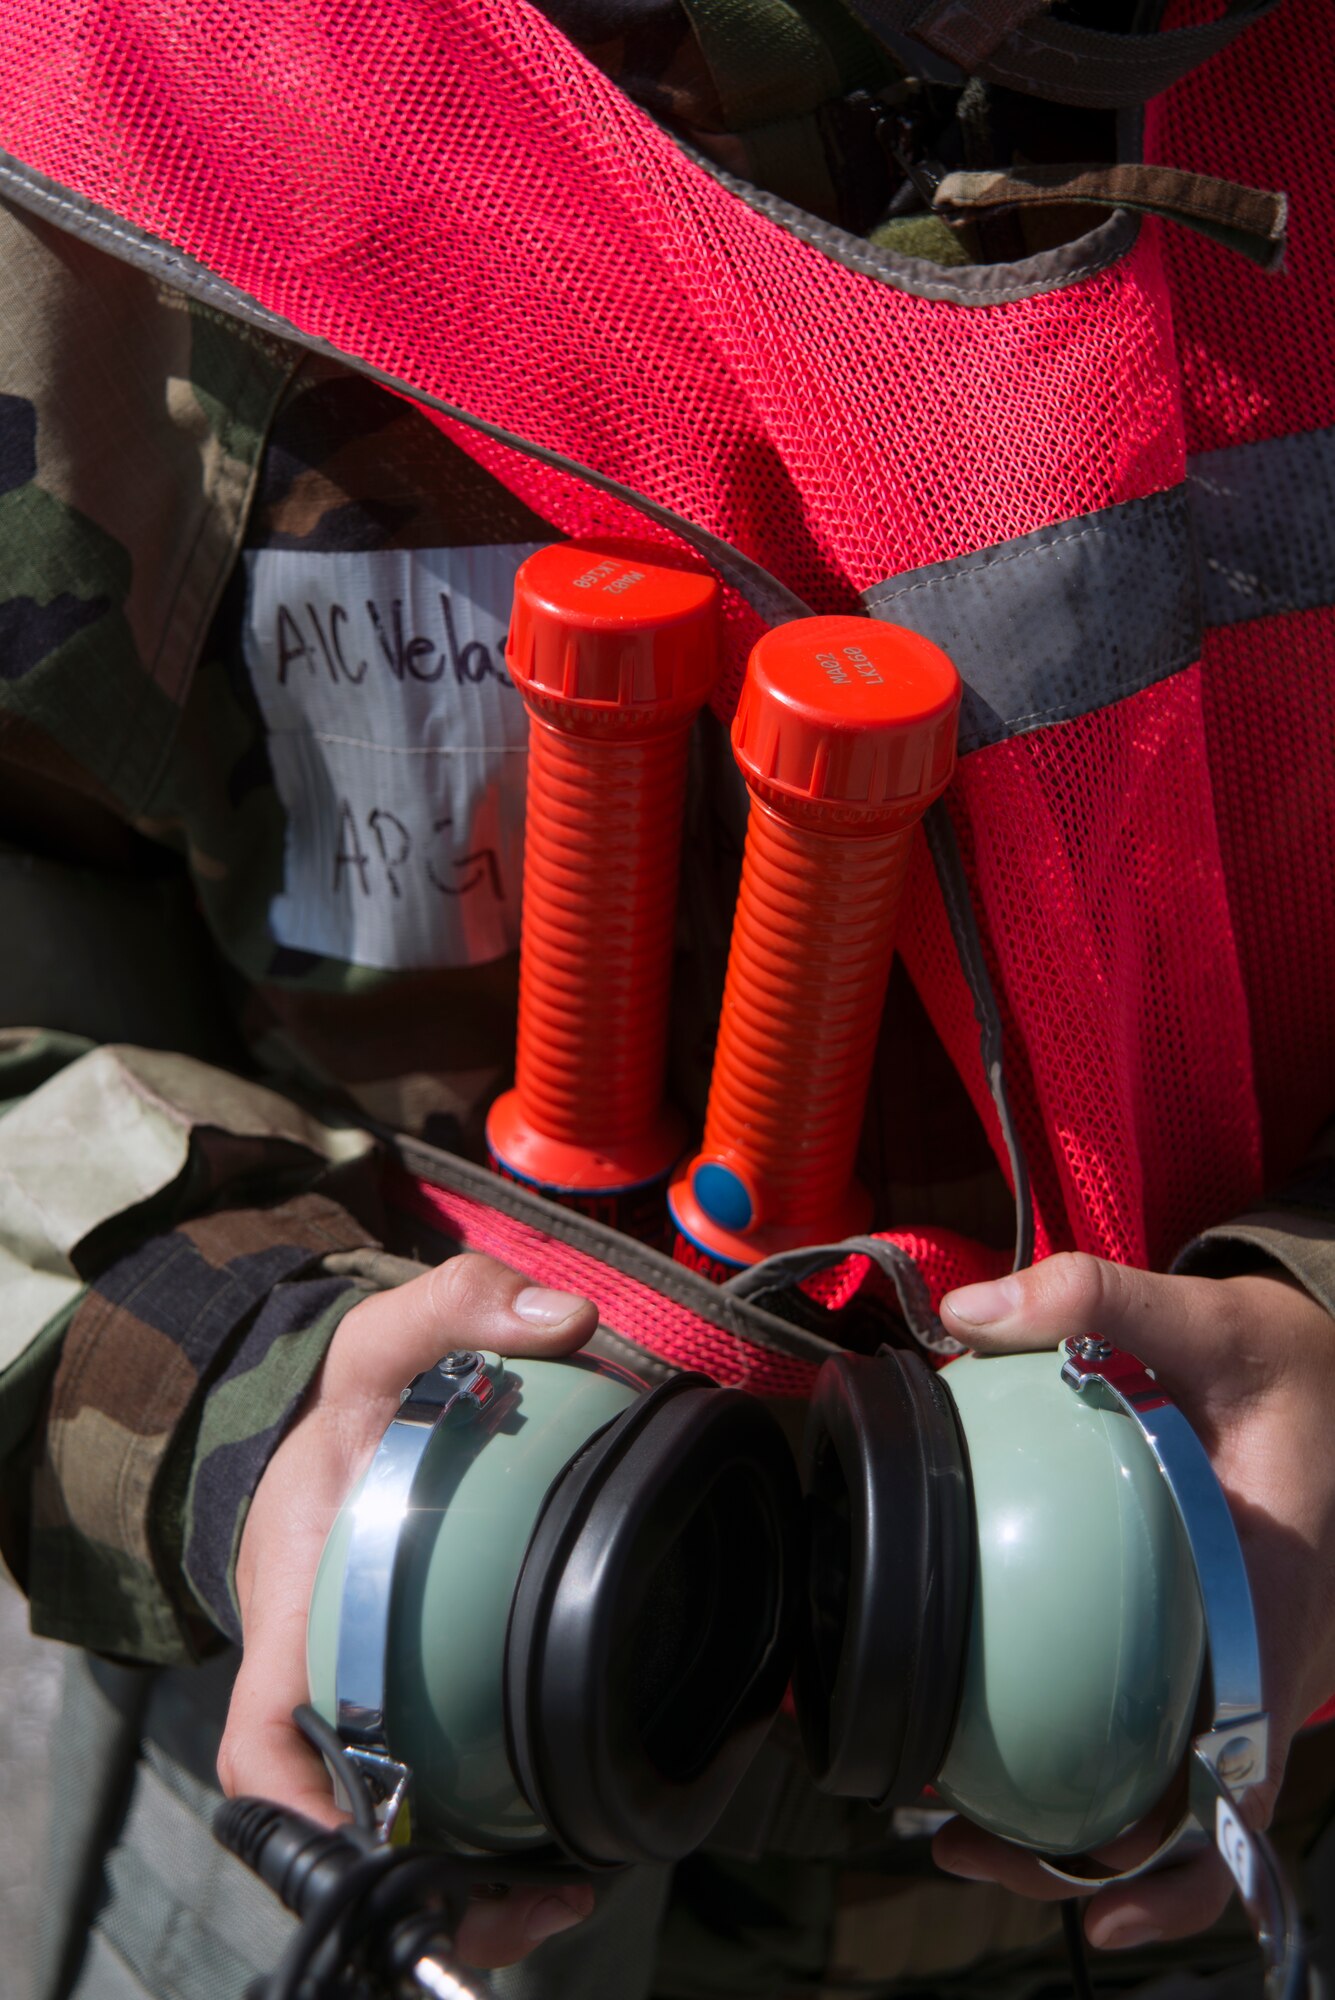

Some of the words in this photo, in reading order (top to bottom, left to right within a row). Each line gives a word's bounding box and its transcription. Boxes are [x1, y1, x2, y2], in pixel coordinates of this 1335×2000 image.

[815, 652, 852, 685] MA02
[843, 646, 884, 685] LK160
[333, 798, 506, 902] APG
